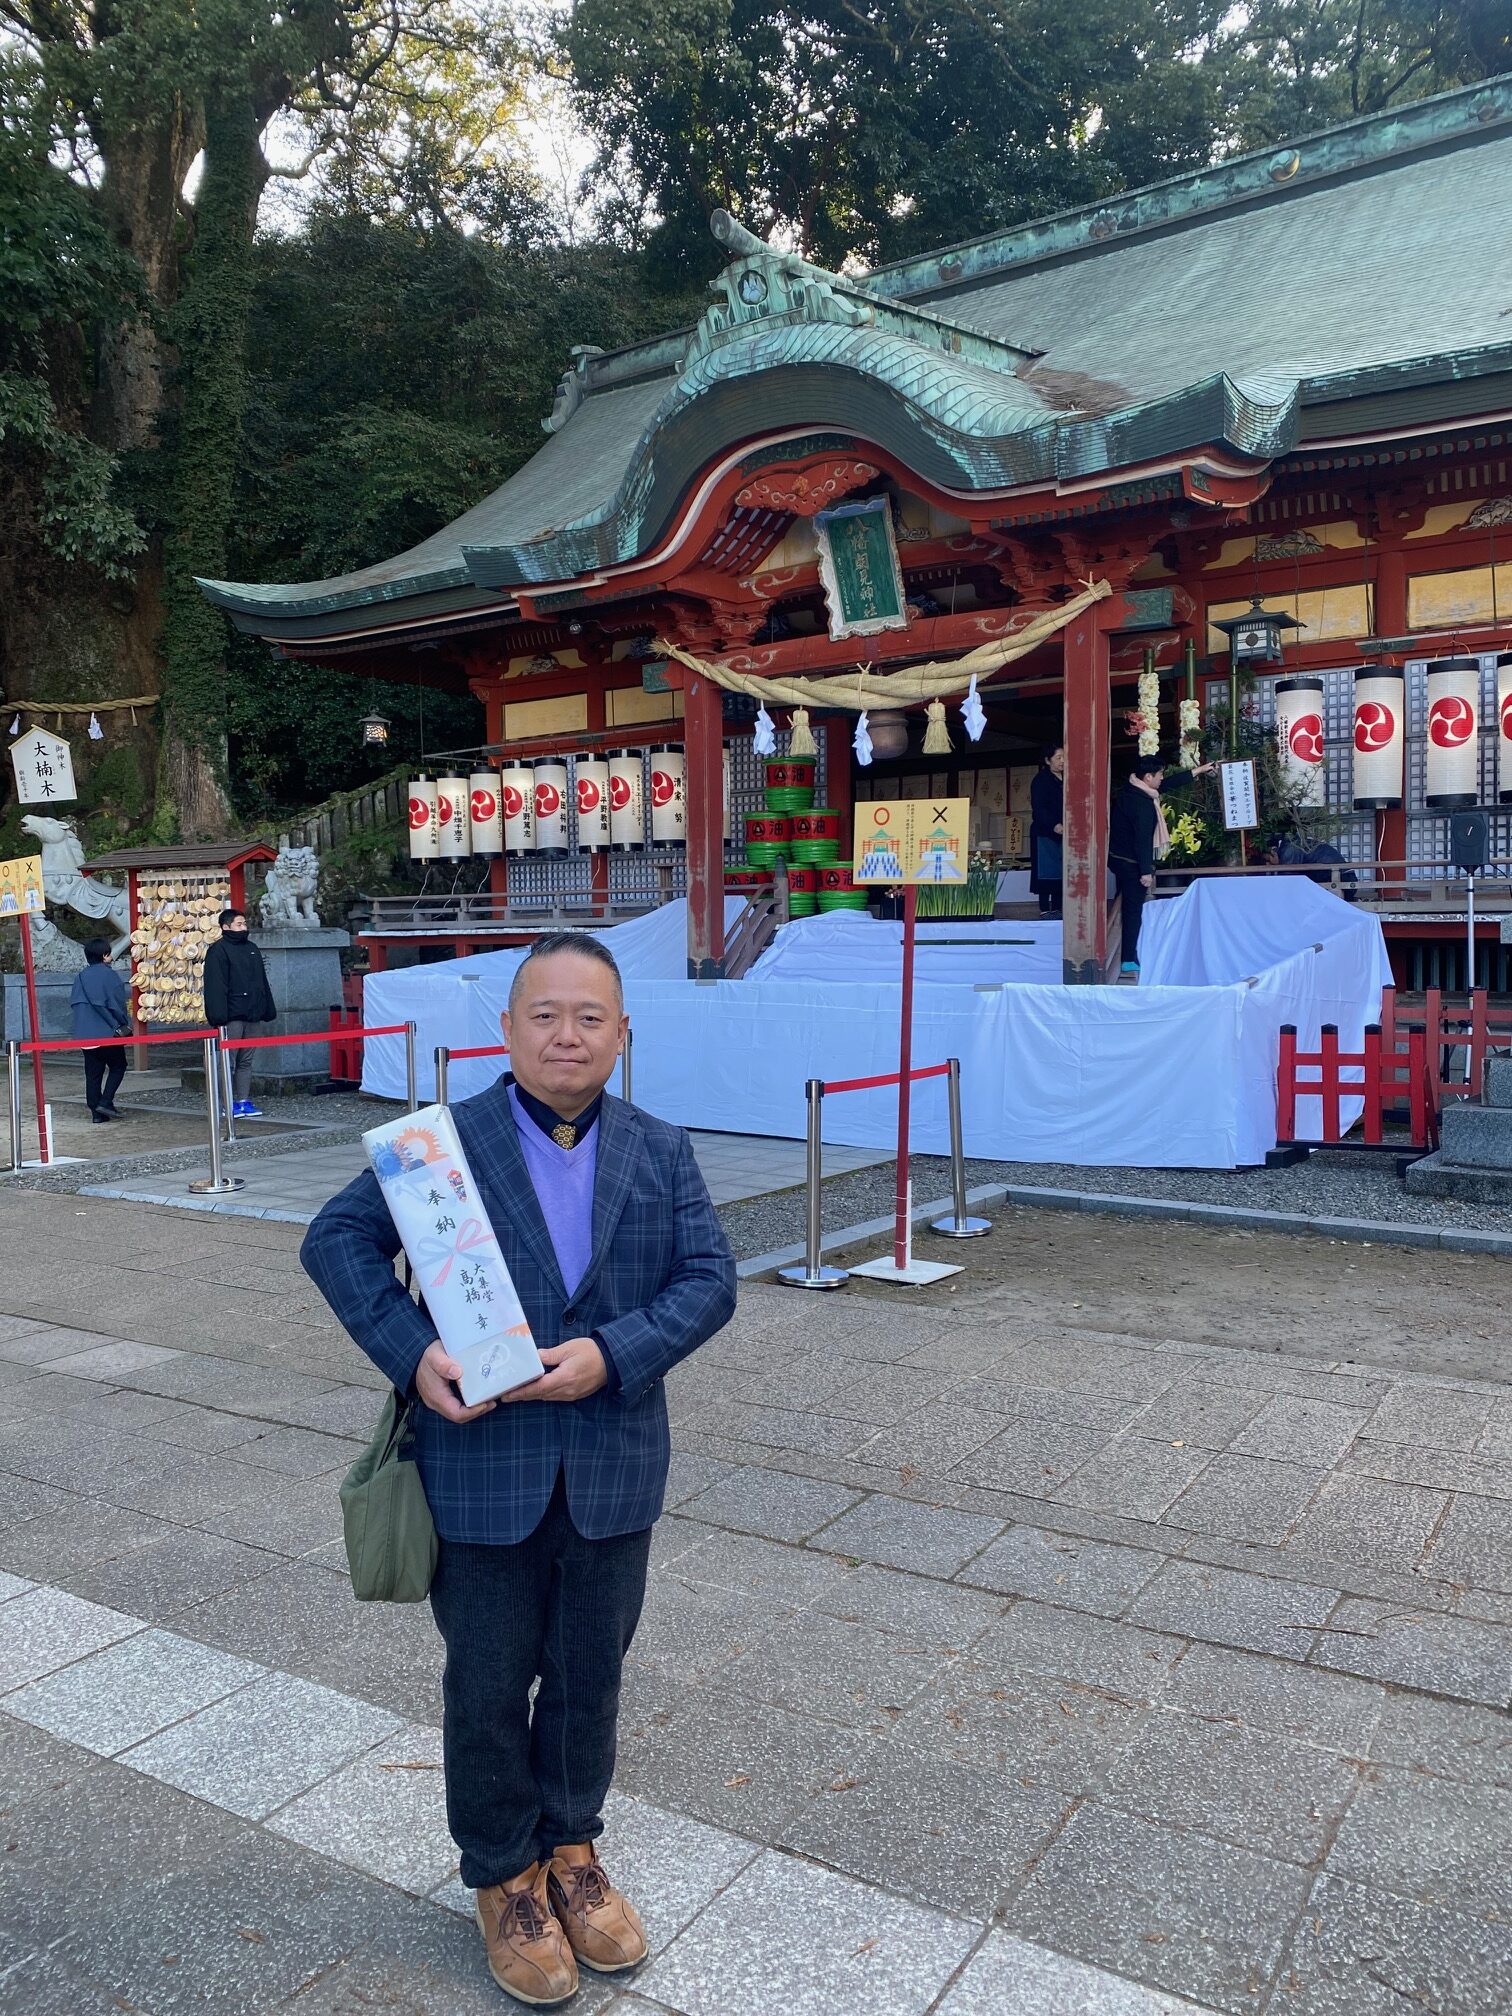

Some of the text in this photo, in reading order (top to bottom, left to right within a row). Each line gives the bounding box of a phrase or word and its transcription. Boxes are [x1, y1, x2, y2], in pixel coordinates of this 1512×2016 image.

[33, 741, 57, 797] 大楠木
[792, 766, 804, 782] 油
[769, 820, 784, 836] 油
[813, 817, 826, 834] 油
[791, 873, 805, 889] 油
[426, 1188, 456, 1235] 奉納
